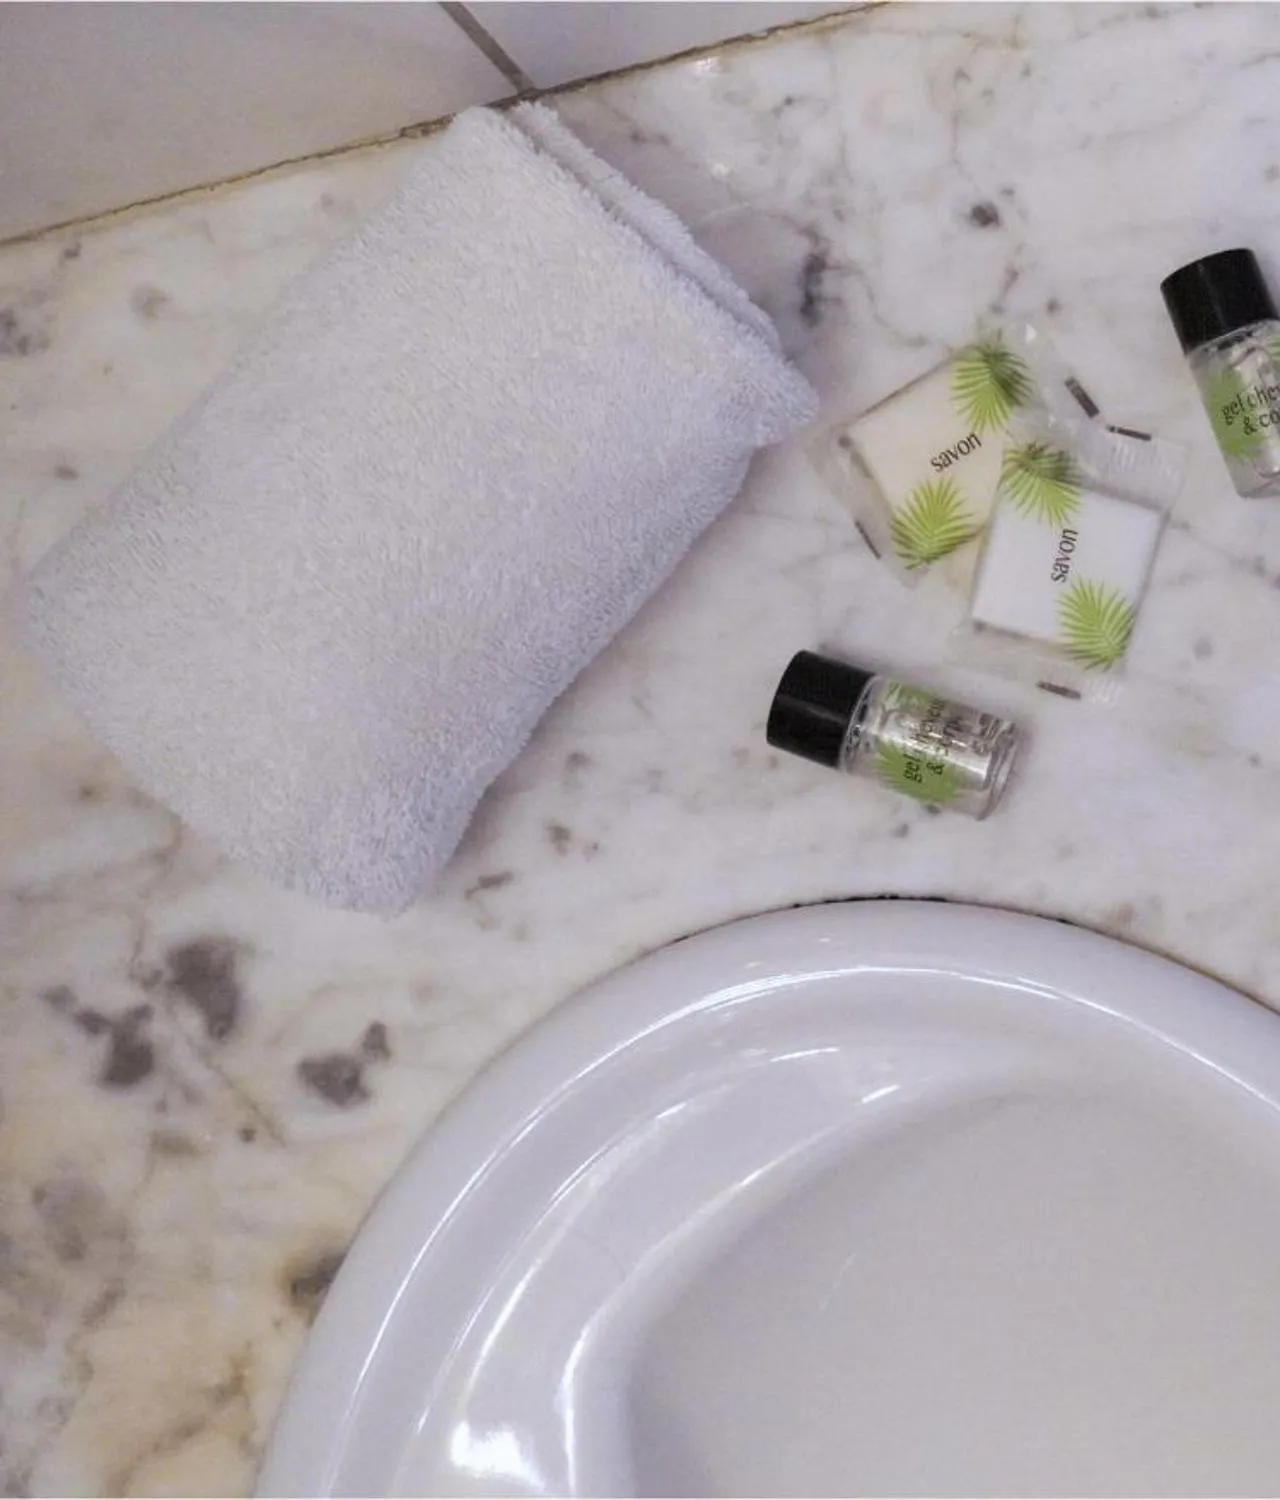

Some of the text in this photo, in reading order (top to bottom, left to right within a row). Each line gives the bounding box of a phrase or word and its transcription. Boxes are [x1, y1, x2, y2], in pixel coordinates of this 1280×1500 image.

[1222, 393, 1245, 426] gel
[1243, 415, 1257, 436] &
[930, 431, 982, 473] savon
[1051, 528, 1079, 583] savon
[903, 752, 923, 784] gel
[926, 760, 945, 776] &
